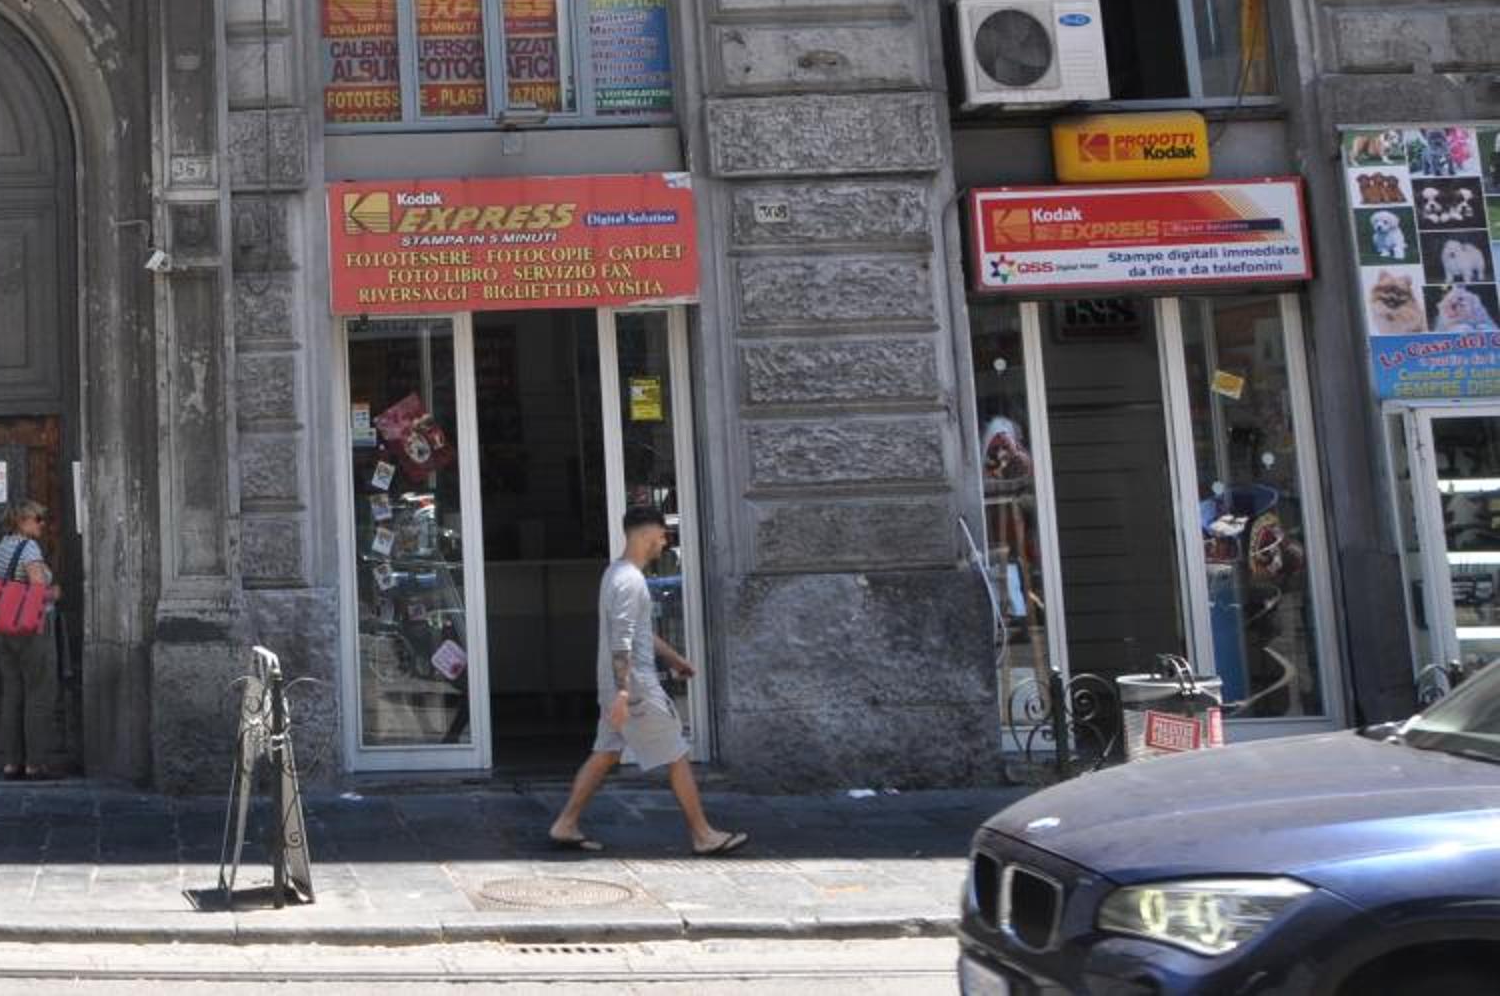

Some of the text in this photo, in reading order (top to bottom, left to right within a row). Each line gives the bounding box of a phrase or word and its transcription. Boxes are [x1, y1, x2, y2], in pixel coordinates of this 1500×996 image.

[1115, 132, 1196, 147] PRODOTTI
[1143, 144, 1197, 160] Kodak
[397, 191, 443, 205] Kodak
[395, 204, 578, 235] EXPRESS
[1032, 207, 1083, 222] Kodak
[1060, 219, 1160, 241] EXPRESS
[401, 234, 464, 248] STAMPA
[468, 234, 485, 245] IN
[501, 232, 558, 244] MINUTI
[346, 243, 684, 269] FOTOTESSERE FOTOCOPIE GADGET
[1108, 243, 1301, 264] Stampe digitali immediate
[388, 267, 439, 285] FOTO
[444, 266, 499, 283] LIBRO
[513, 262, 597, 282] SERVIZIO
[601, 261, 633, 278] FAX
[1017, 261, 1054, 274] QSS
[1128, 260, 1283, 278] da file e da telefonini
[357, 284, 469, 304] RIVERSAGGI
[483, 281, 573, 301] BIGLIETTI
[576, 282, 600, 298] DA
[605, 277, 664, 297] VISITA
